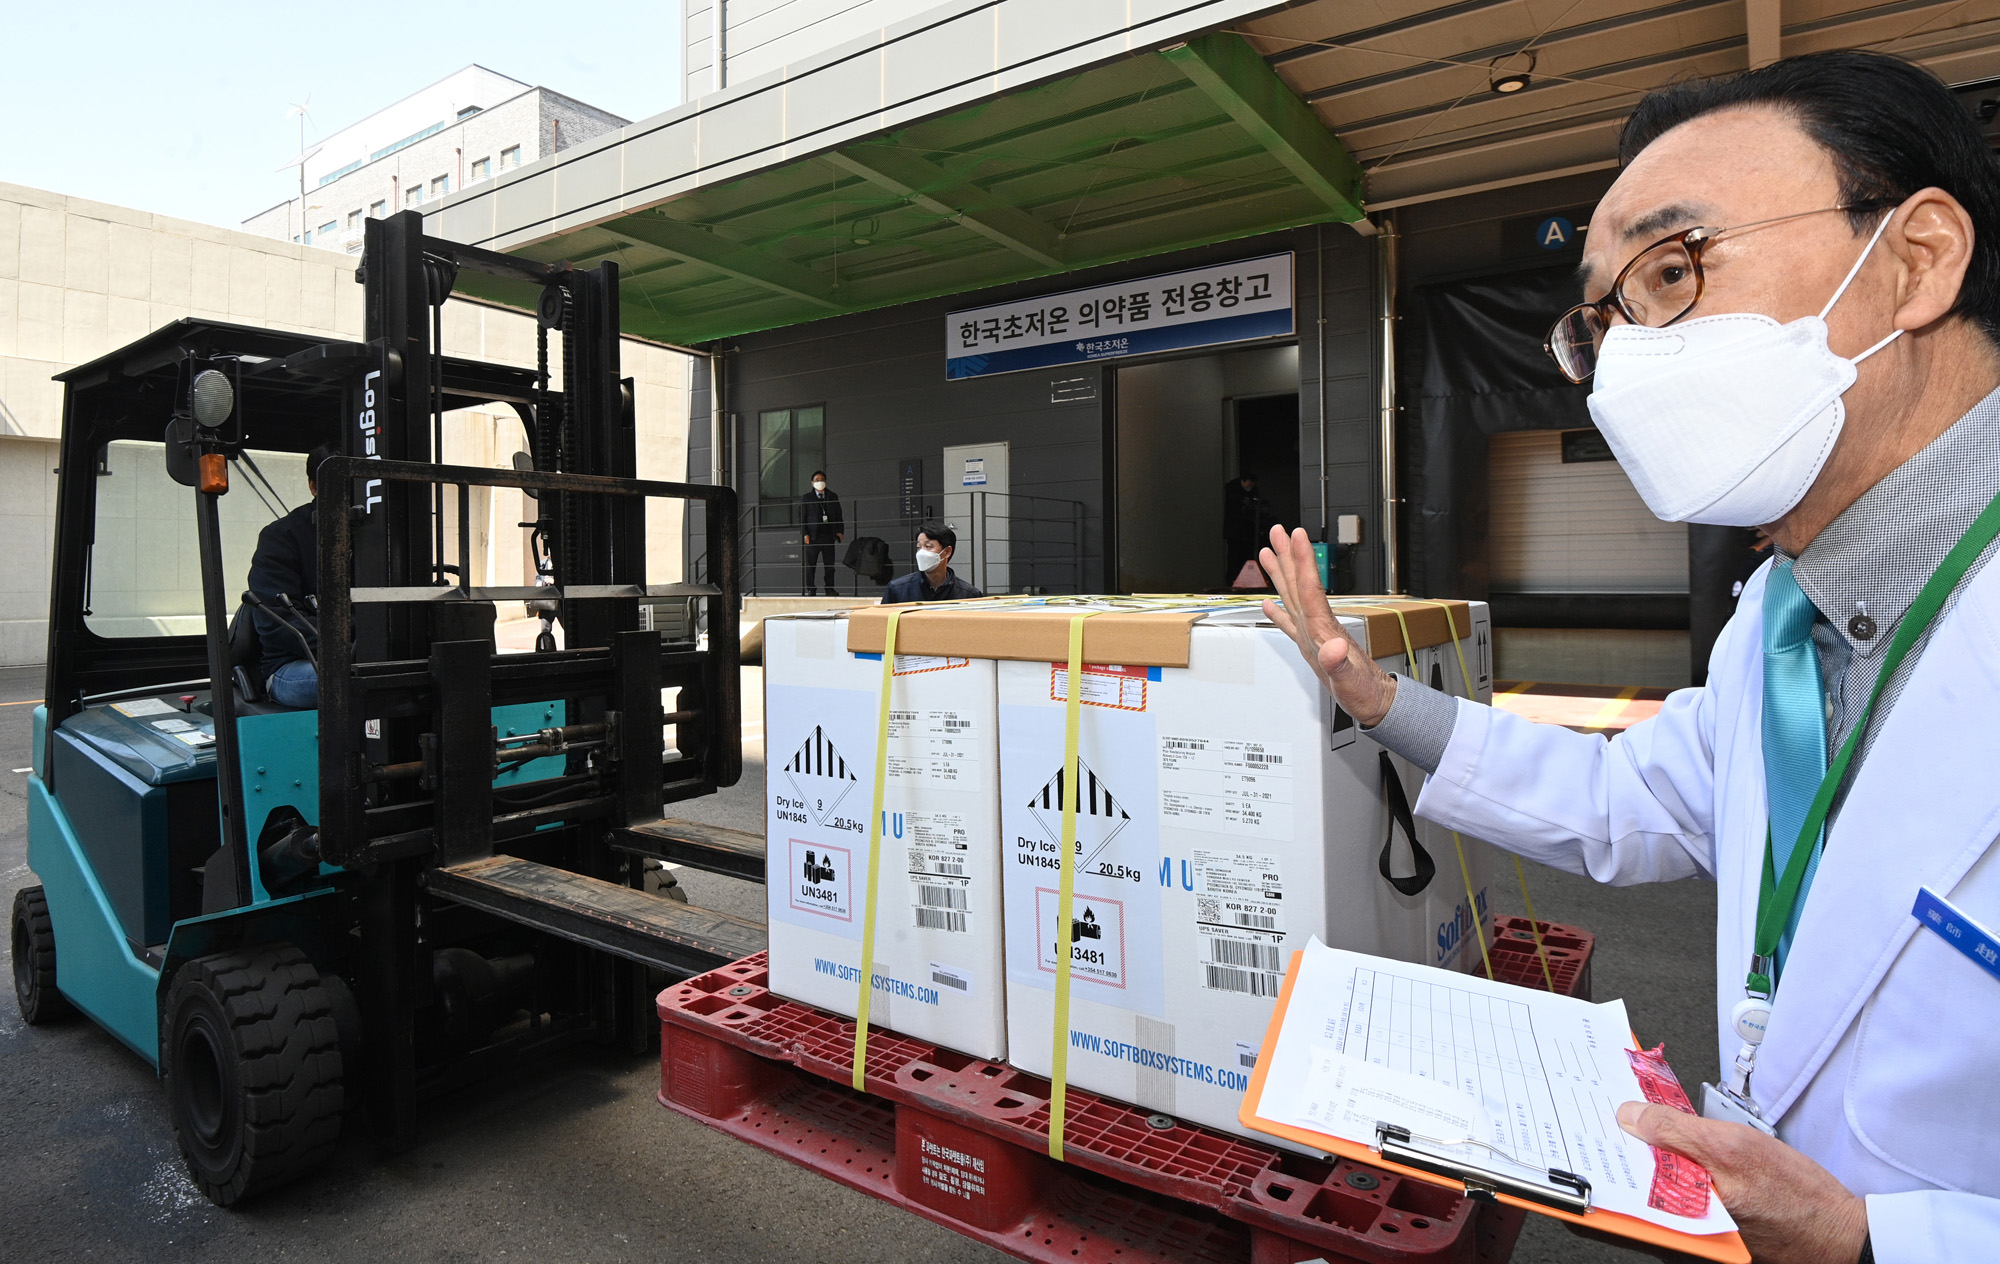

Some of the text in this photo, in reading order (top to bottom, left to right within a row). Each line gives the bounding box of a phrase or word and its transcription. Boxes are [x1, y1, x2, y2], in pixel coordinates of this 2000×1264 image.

[1544, 221, 1565, 244] A
[960, 273, 1272, 348] 한국초저온 의약품 전용창고
[1086, 338, 1129, 353] 한국초저온
[360, 370, 382, 514] LogisLL
[776, 796, 804, 809] Dry Ice
[817, 799, 822, 808] 9
[777, 810, 807, 824] UN1845
[1018, 837, 1056, 853] Dry Ice
[1018, 853, 1061, 870] UN1845
[802, 885, 837, 903] UN3481
[1260, 907, 1276, 915] 2-00
[1271, 935, 1283, 943] 1P
[1071, 1030, 1247, 1092] WWW.SOFTBOXSYSTEMS.COM
